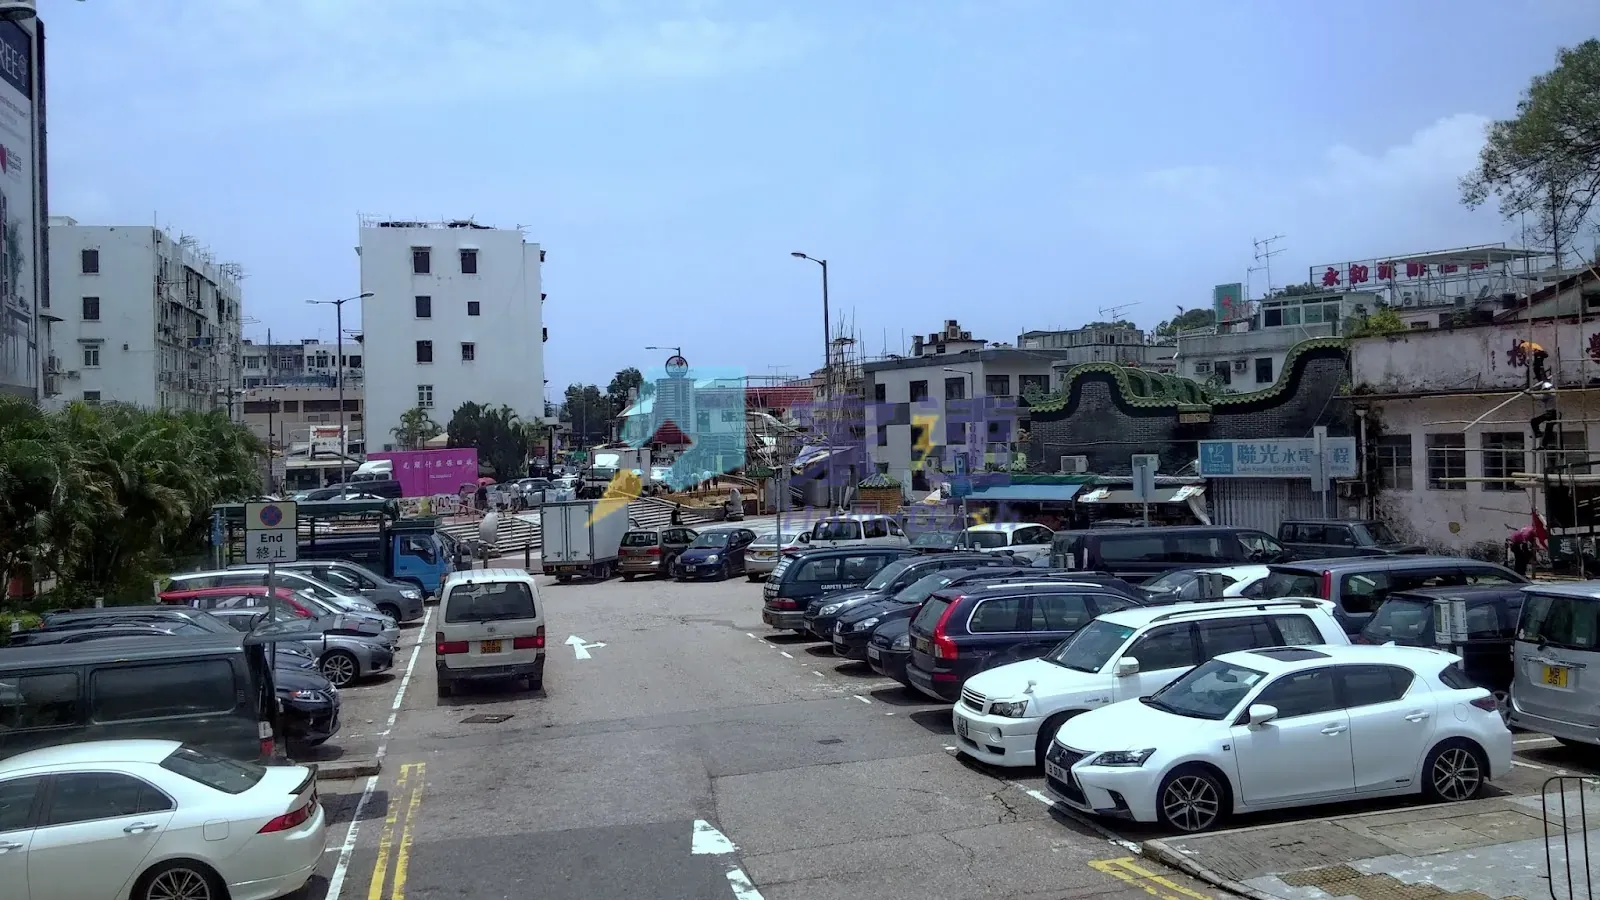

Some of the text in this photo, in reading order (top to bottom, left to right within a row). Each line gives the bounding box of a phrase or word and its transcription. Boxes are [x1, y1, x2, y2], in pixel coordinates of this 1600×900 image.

[1236, 444, 1350, 465] 聯光水電程
[260, 532, 283, 543] End
[256, 546, 287, 559] 終止
